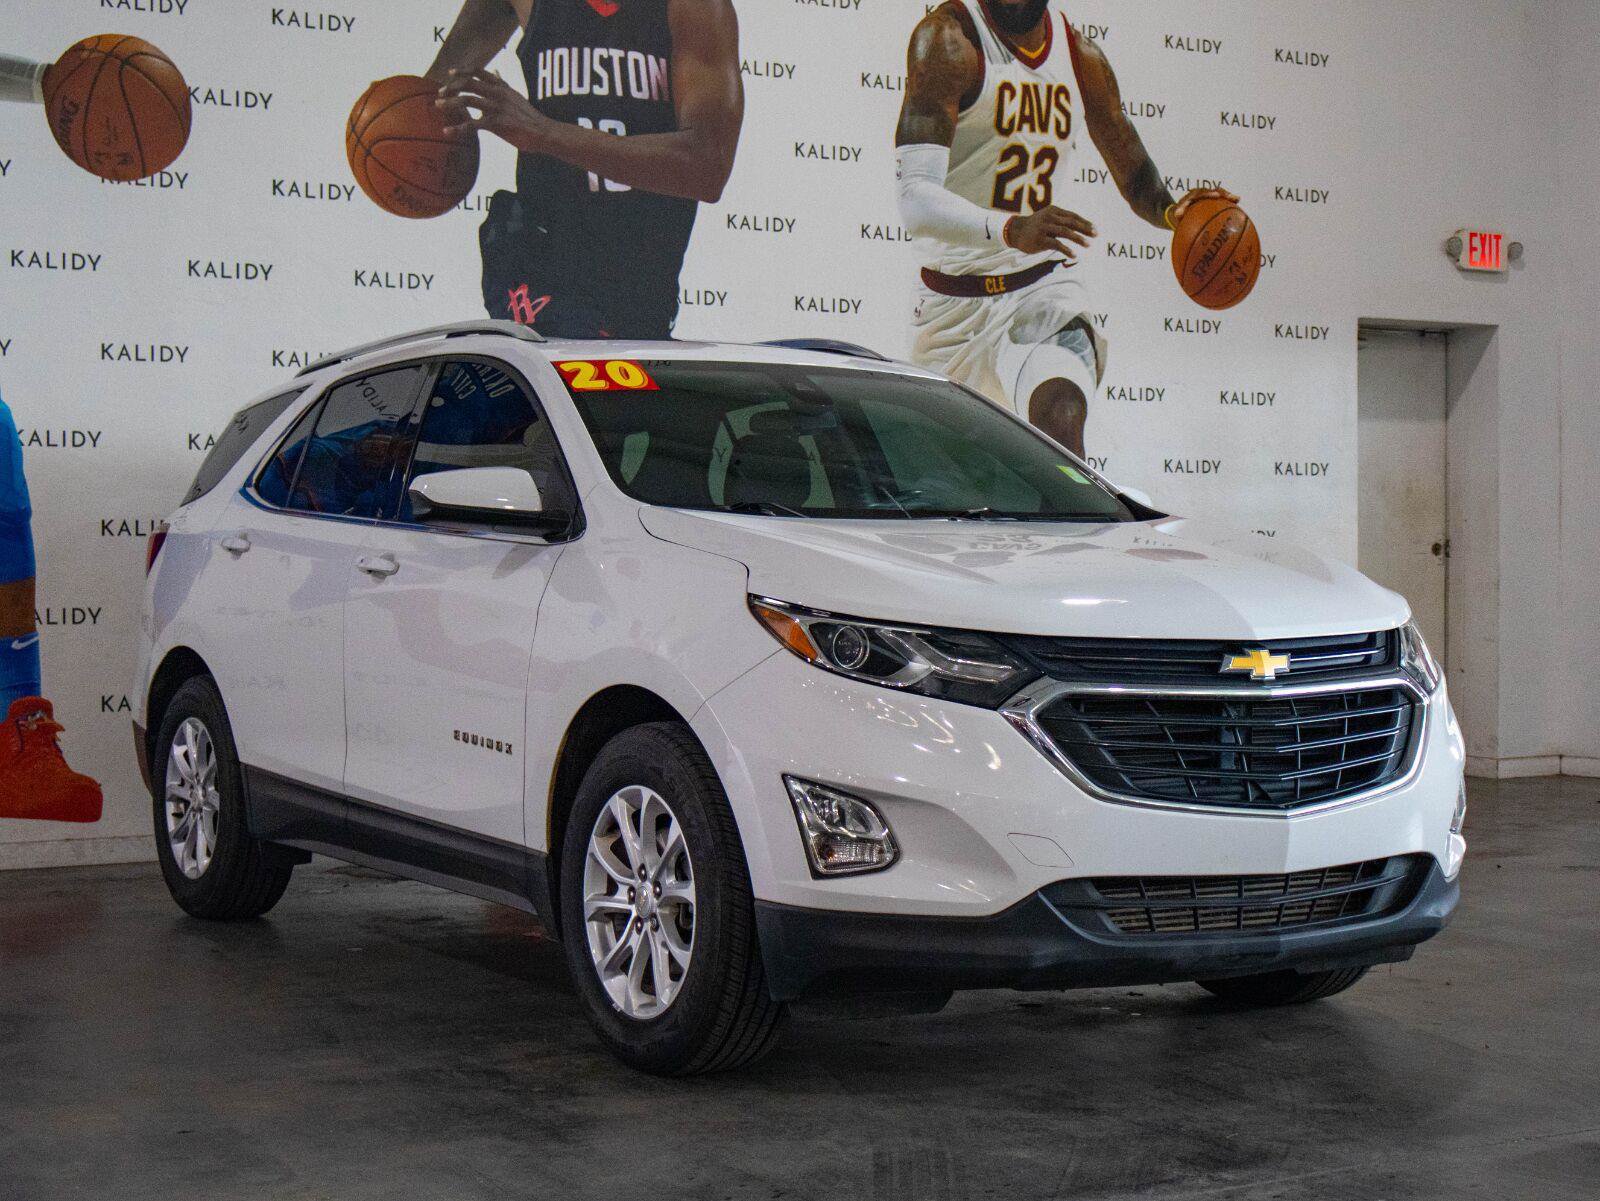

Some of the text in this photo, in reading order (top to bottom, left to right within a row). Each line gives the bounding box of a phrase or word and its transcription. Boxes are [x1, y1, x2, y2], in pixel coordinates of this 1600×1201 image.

[272, 8, 355, 33] KALIDY
[1165, 35, 1222, 54] KALIDY
[1275, 49, 1329, 67] KALIDY
[538, 47, 669, 100] HOUSTON
[742, 60, 795, 79] ALIDY
[861, 73, 908, 91] KALI
[187, 87, 272, 109] KALIDY
[994, 80, 1072, 140] CAVS
[1120, 102, 1165, 118] ALIDY
[1221, 112, 1276, 130] KALIDY
[795, 142, 861, 162] KALIDY
[991, 142, 1059, 214] 23
[272, 180, 355, 201] KALIDY
[1275, 187, 1329, 203] KALIDY
[727, 214, 795, 233] KALIDY
[1107, 243, 1165, 260] KALIDY
[1469, 232, 1501, 268] EXIT
[11, 250, 101, 271] KALIDY
[188, 260, 273, 281] KALIDY
[355, 270, 434, 290] KALIDY
[985, 276, 1005, 294] CLE
[679, 289, 727, 306] LIDY
[795, 296, 861, 314] KALIDY
[1164, 318, 1221, 334] KALIDY
[1275, 324, 1329, 340] KALIDY
[101, 343, 188, 363] KALIDY
[560, 361, 649, 389] 20
[1107, 386, 1165, 401] KALIDY
[1220, 391, 1275, 406] KALIDY
[1164, 459, 1221, 474] KALIDY
[1275, 462, 1329, 476] KALIDY
[101, 519, 161, 537] KALI
